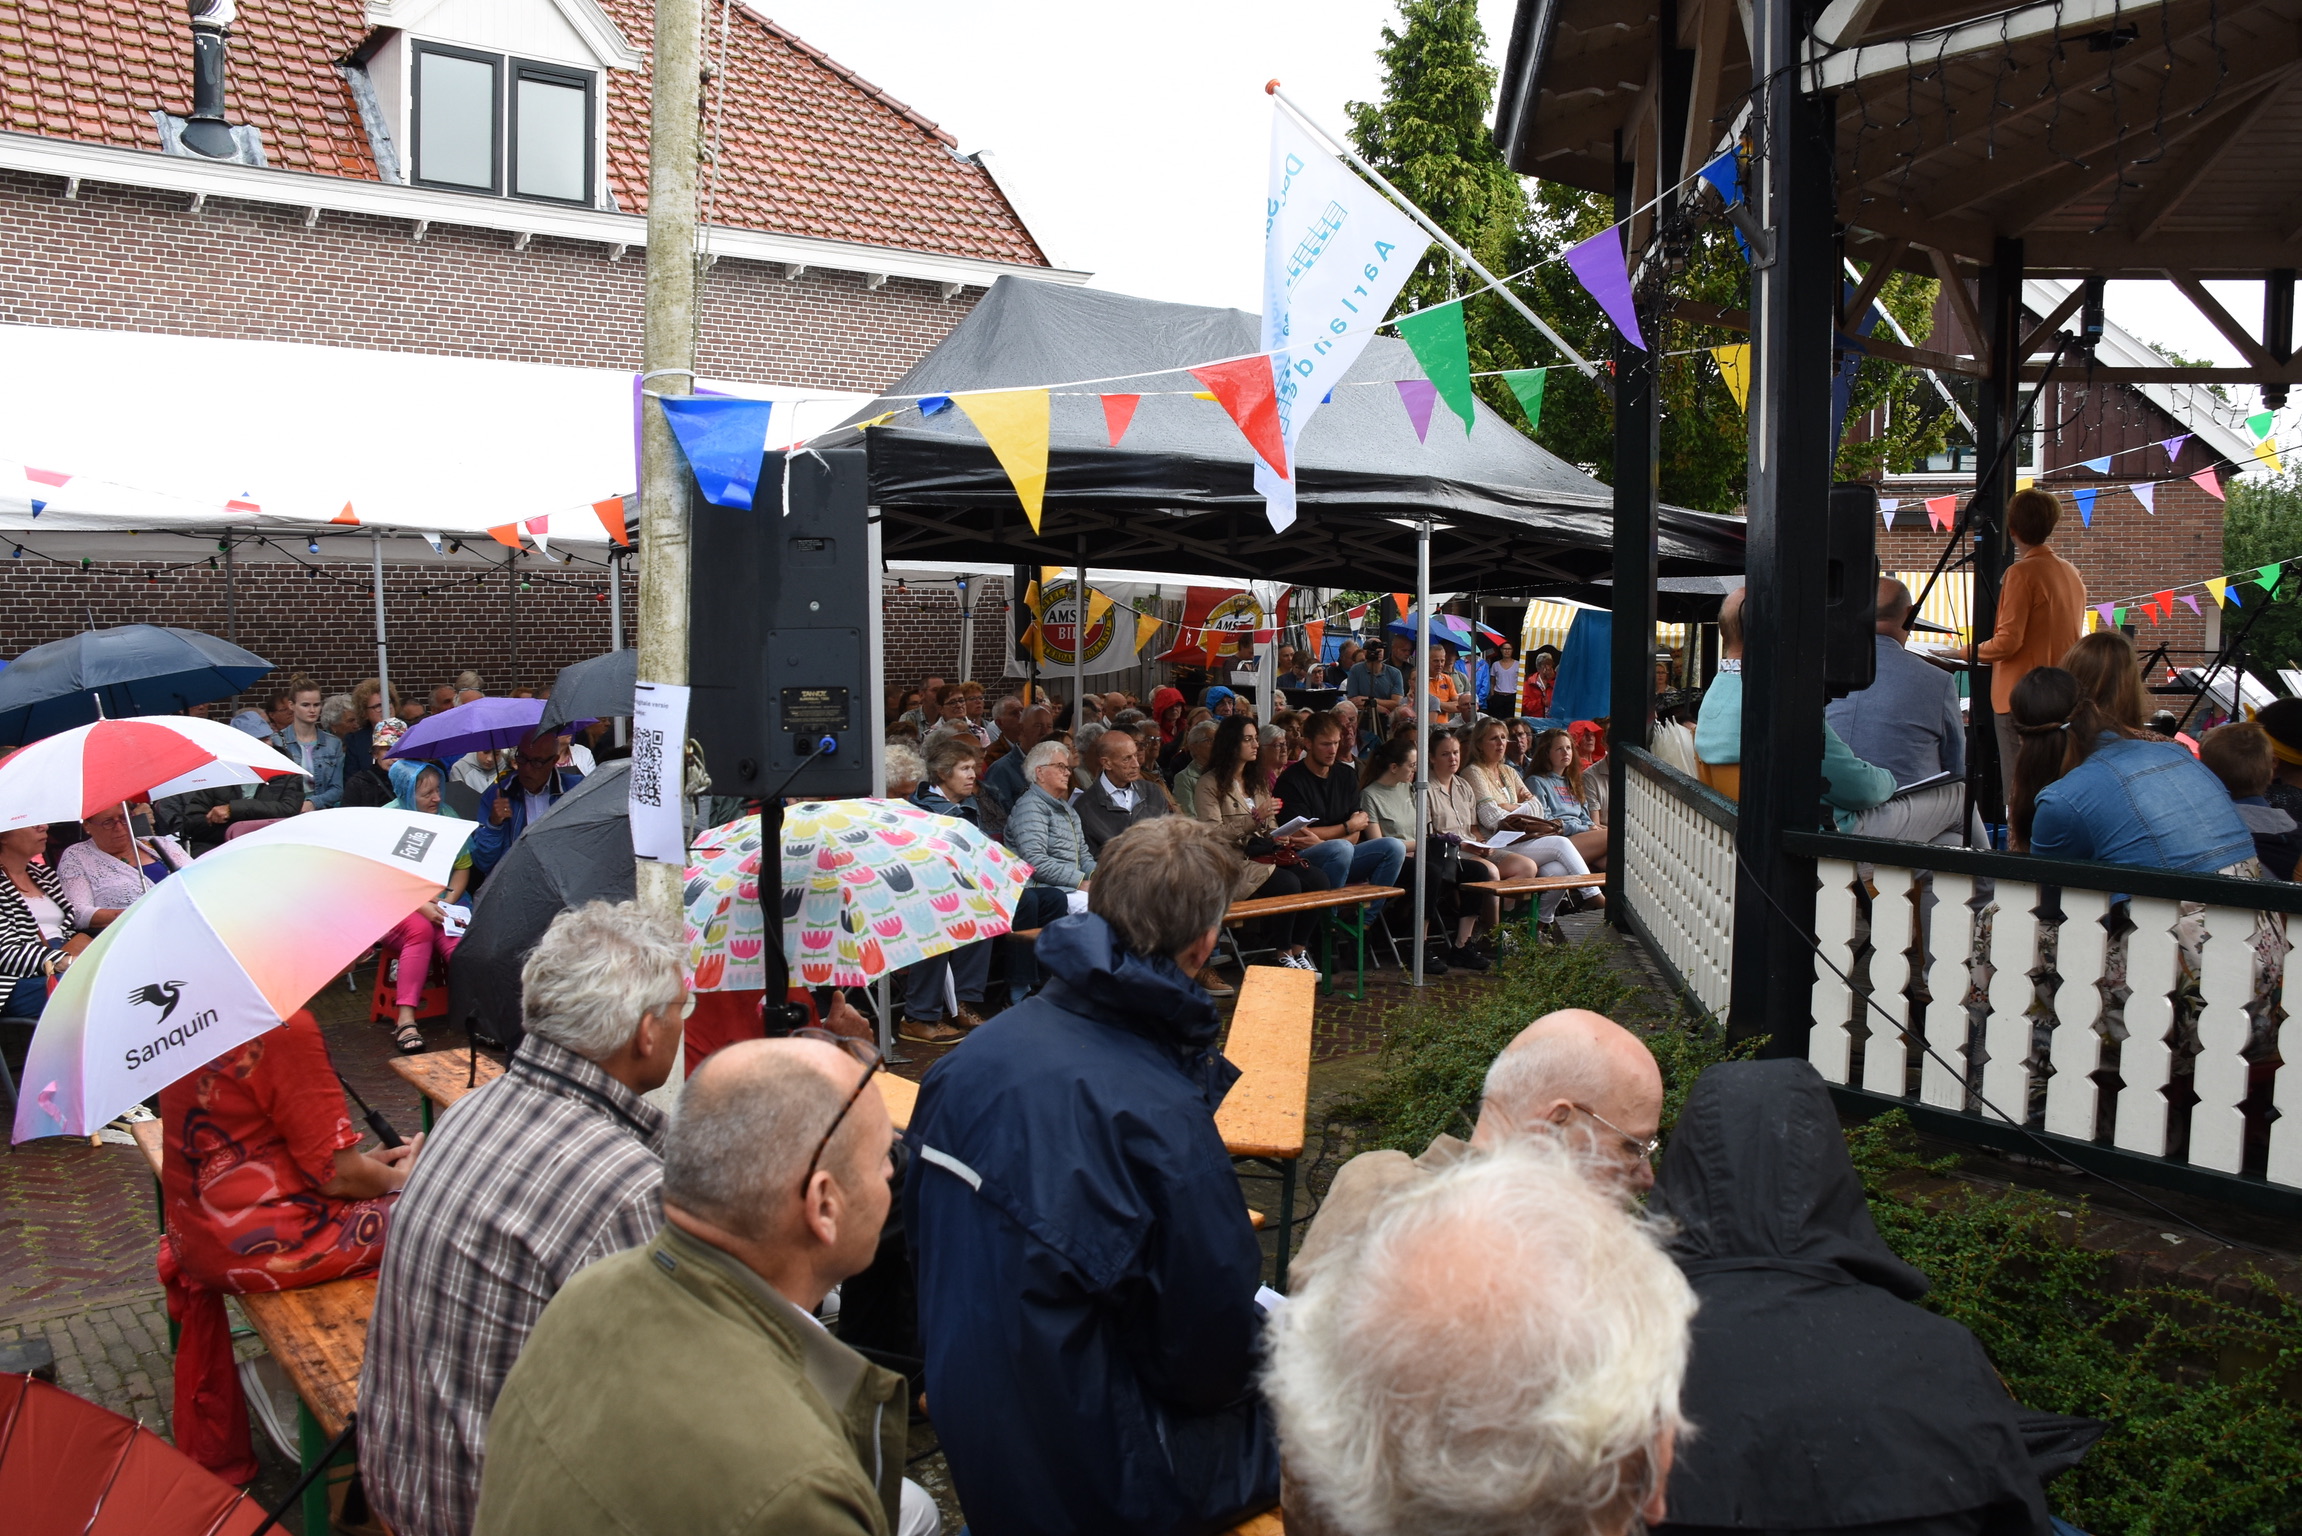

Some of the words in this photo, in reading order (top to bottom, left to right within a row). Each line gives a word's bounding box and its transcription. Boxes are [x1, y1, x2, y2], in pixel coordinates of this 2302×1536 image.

[1047, 609, 1100, 623] AMS
[399, 844, 421, 859] For
[125, 1008, 219, 1070] Sanquin
